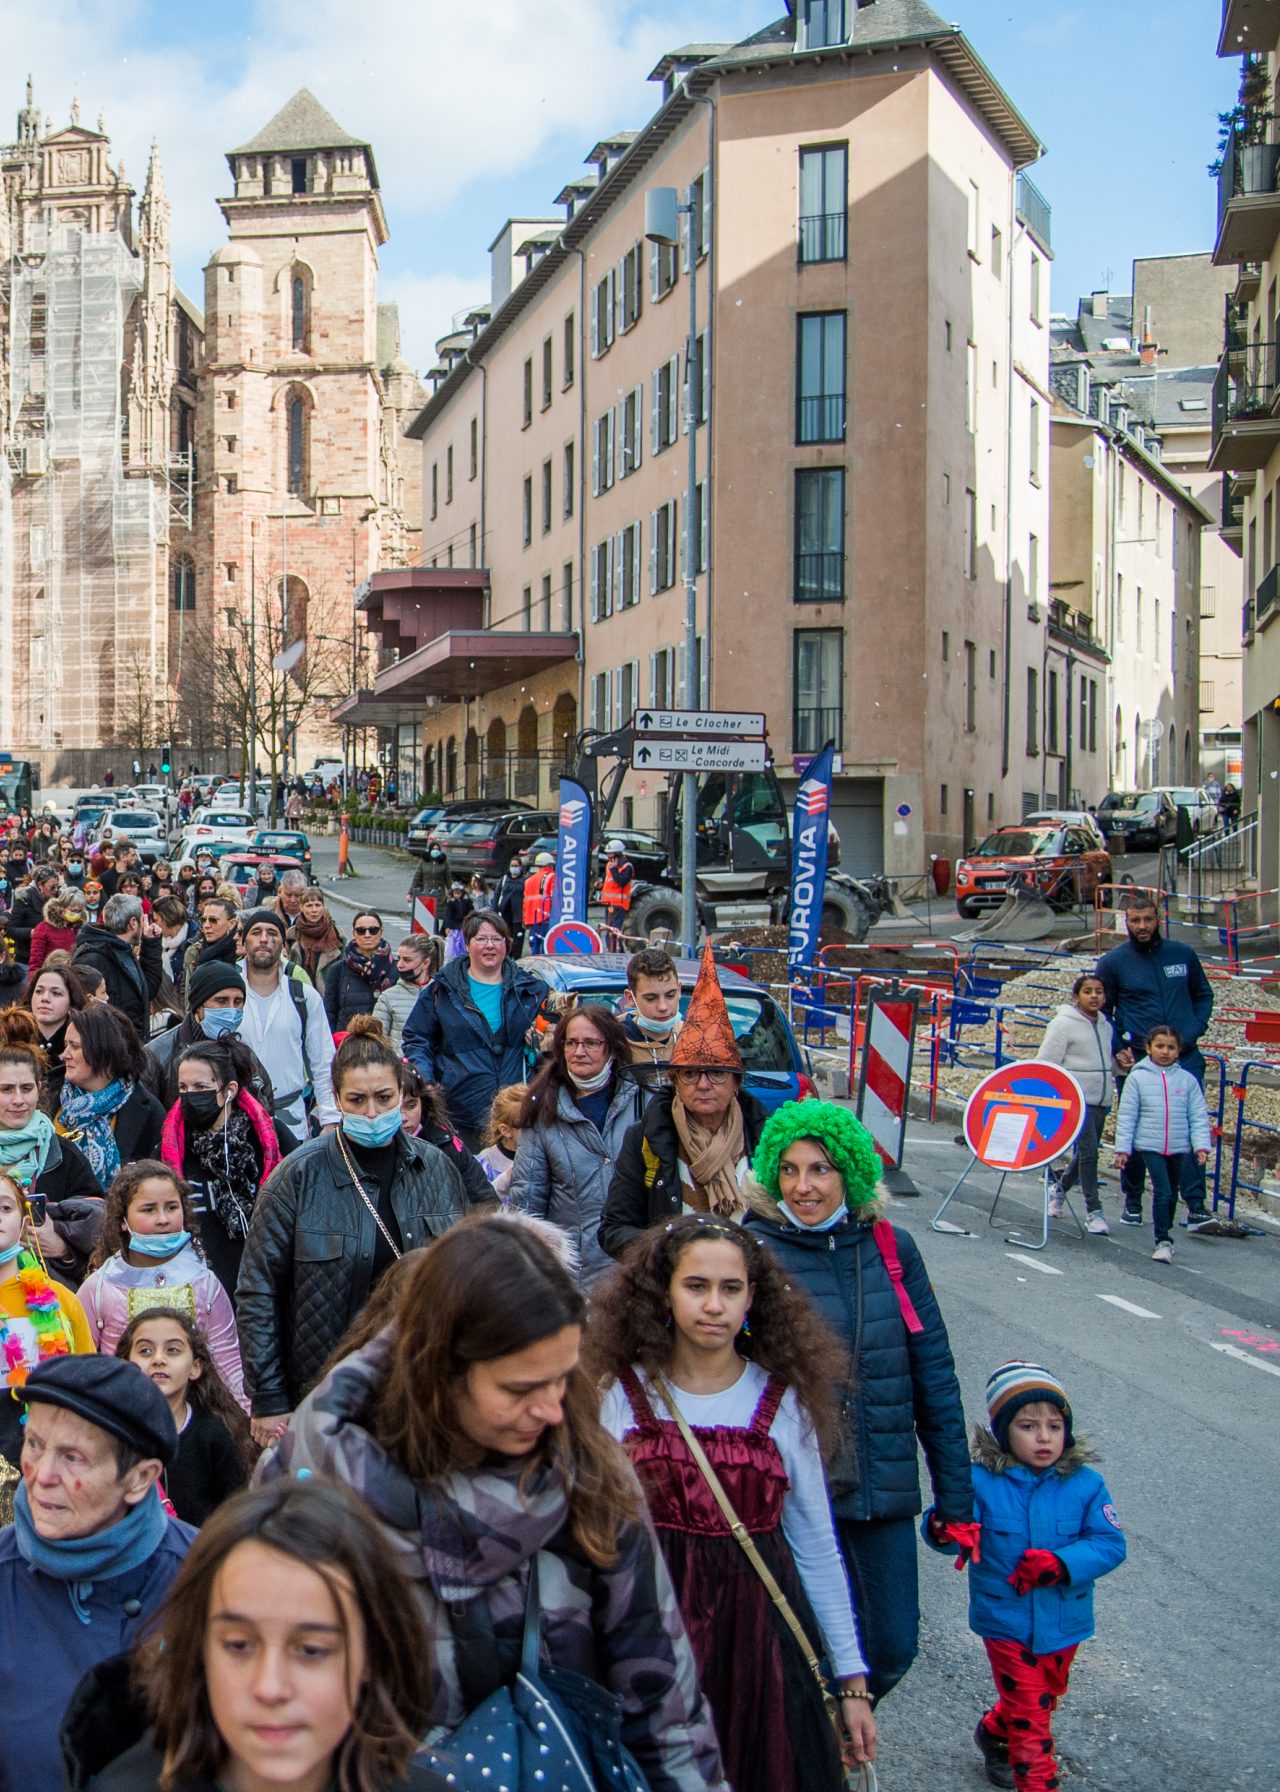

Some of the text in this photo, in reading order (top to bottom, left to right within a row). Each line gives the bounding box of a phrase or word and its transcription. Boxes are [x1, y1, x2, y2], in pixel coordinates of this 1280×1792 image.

[676, 717, 742, 729] Le Clocher
[691, 745, 730, 755] Le Midi
